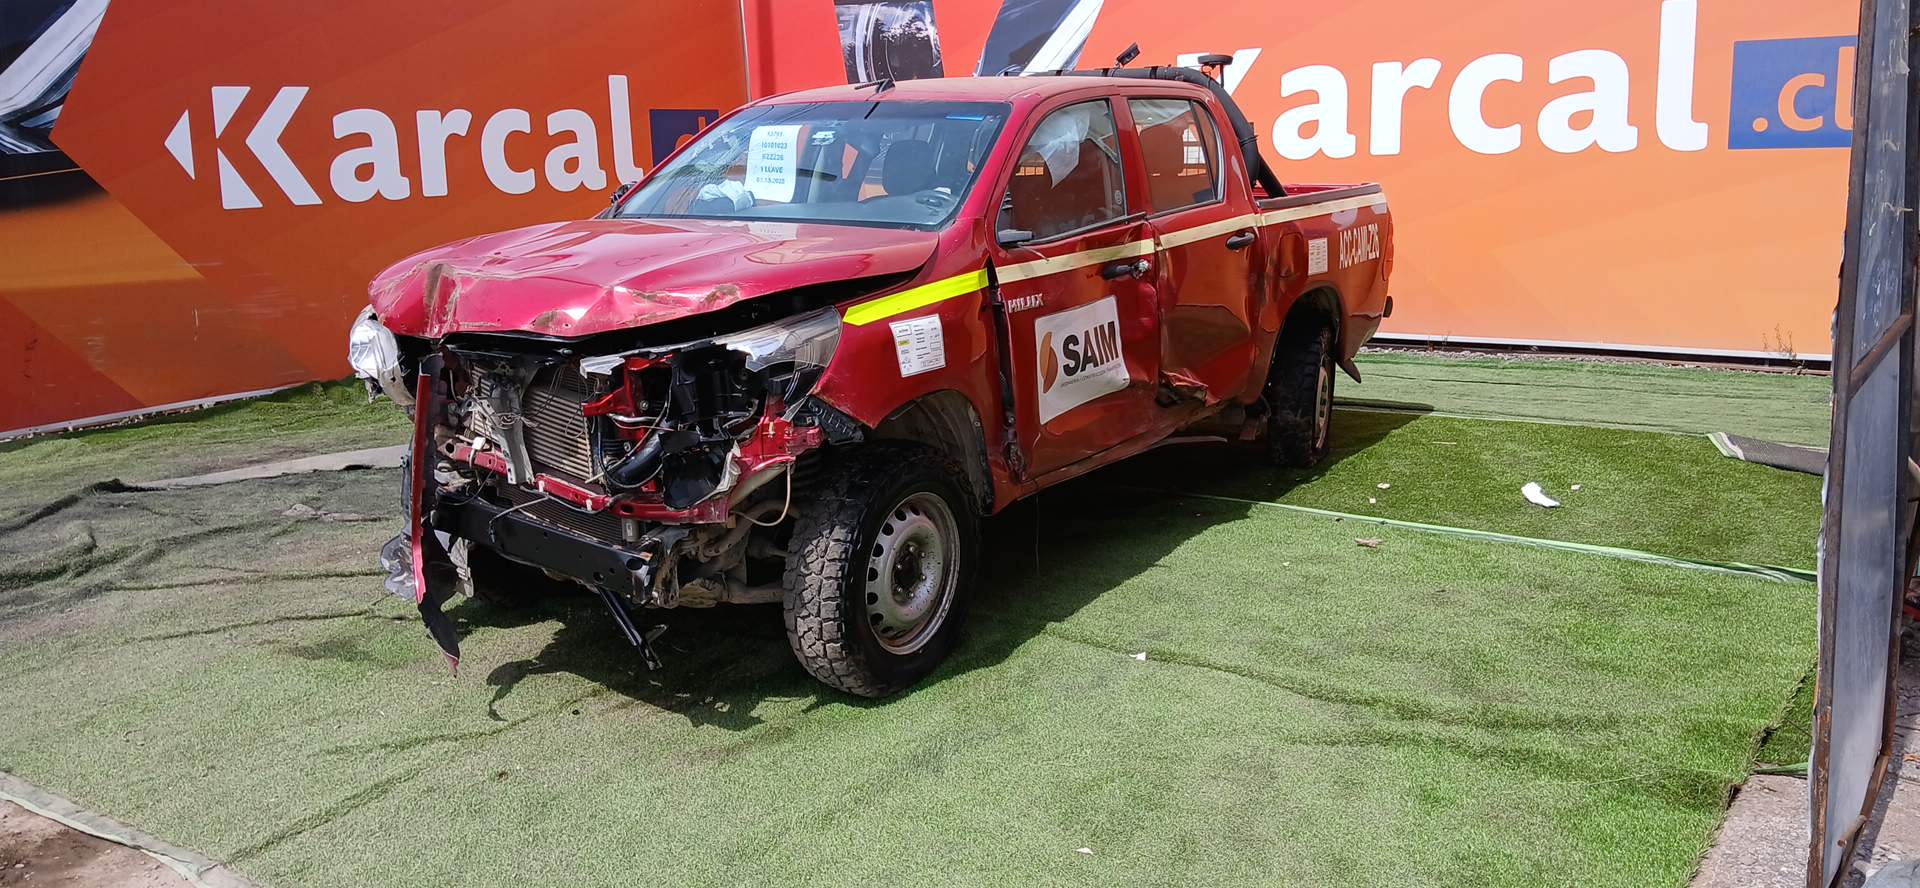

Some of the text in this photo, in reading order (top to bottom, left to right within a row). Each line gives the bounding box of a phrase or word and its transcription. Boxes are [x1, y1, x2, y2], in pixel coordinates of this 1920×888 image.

[164, 75, 644, 210] Karcal
[1008, 293, 1044, 313] HILUX
[1062, 320, 1119, 377] SAIM
